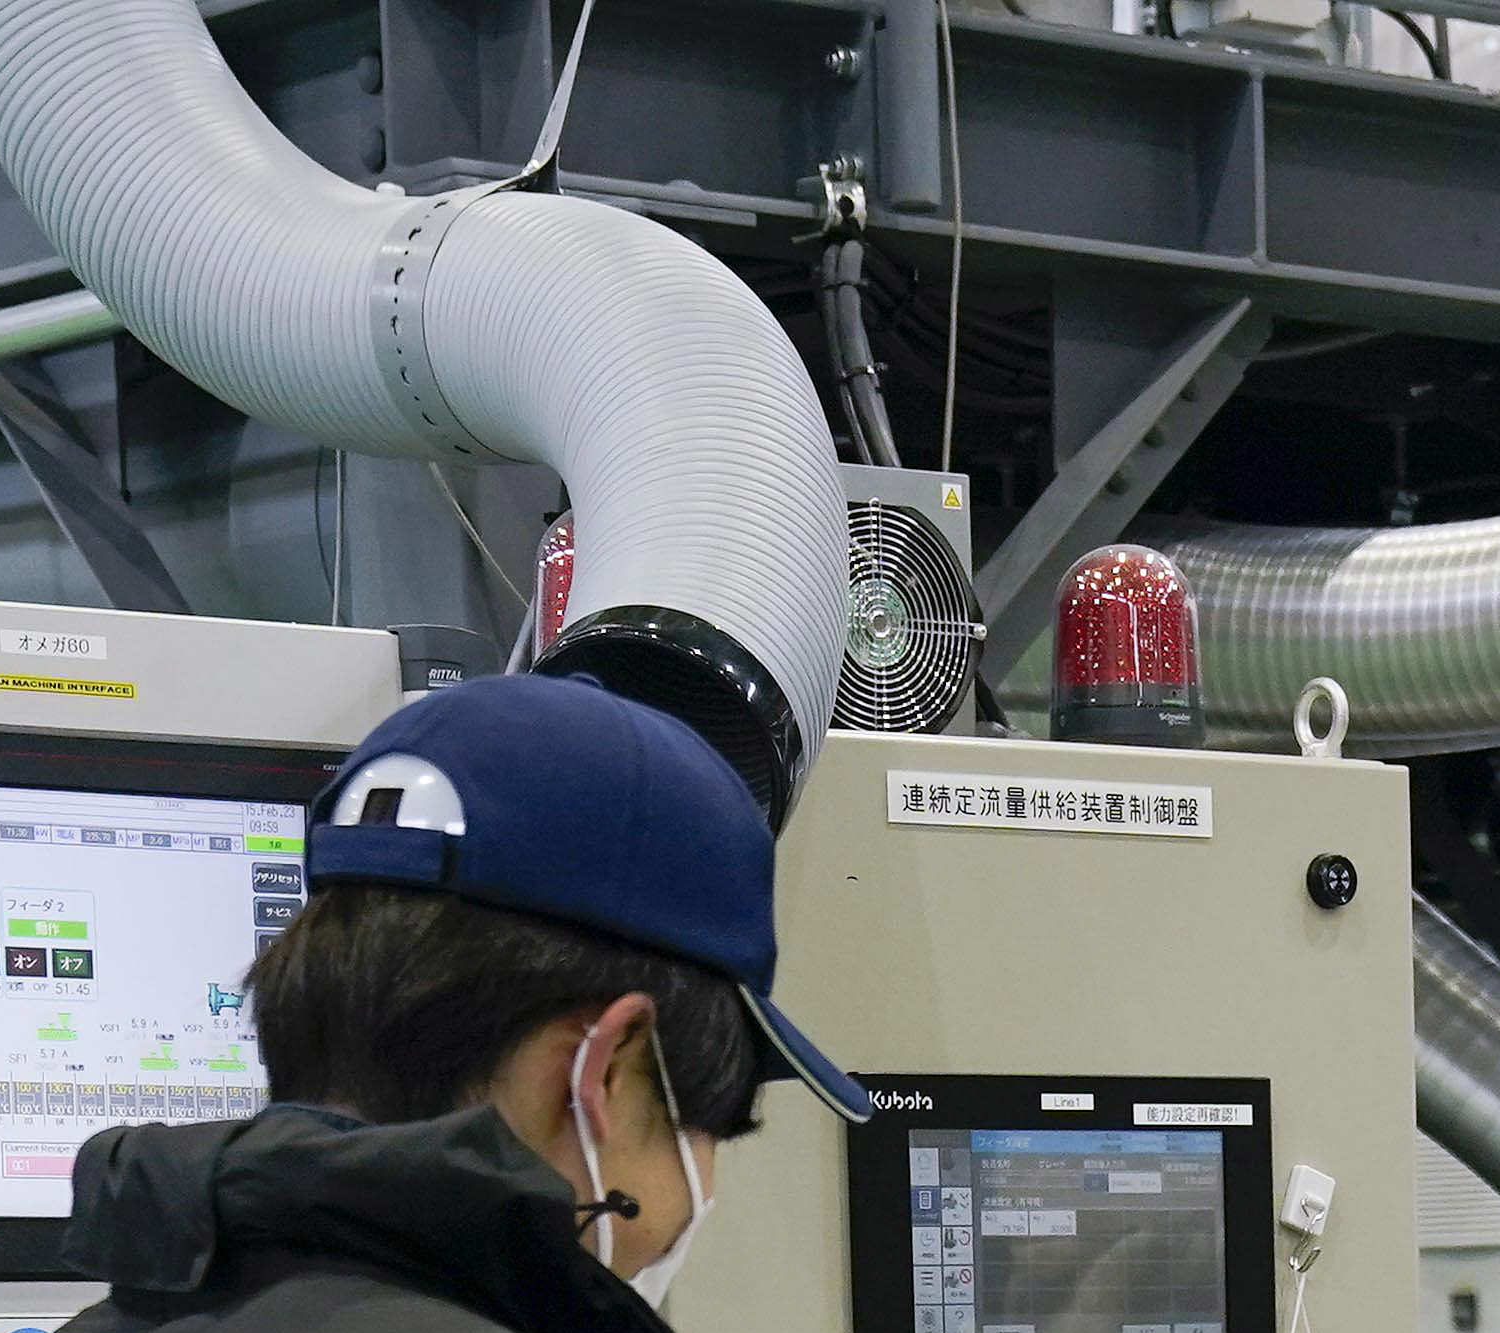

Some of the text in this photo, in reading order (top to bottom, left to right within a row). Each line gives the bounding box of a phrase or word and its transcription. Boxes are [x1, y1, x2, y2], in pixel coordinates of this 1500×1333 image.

[19, 634, 90, 654] オメガ60
[12, 680, 64, 691] MACHINE
[67, 684, 131, 695] INTERFACE
[902, 783, 1199, 826] 連続定流量供給装置制御盤
[250, 821, 279, 834] 09:59
[13, 954, 38, 970] オン
[60, 956, 84, 971] オフ
[55, 983, 91, 996] 51.45
[868, 1090, 933, 1111] Kubota
